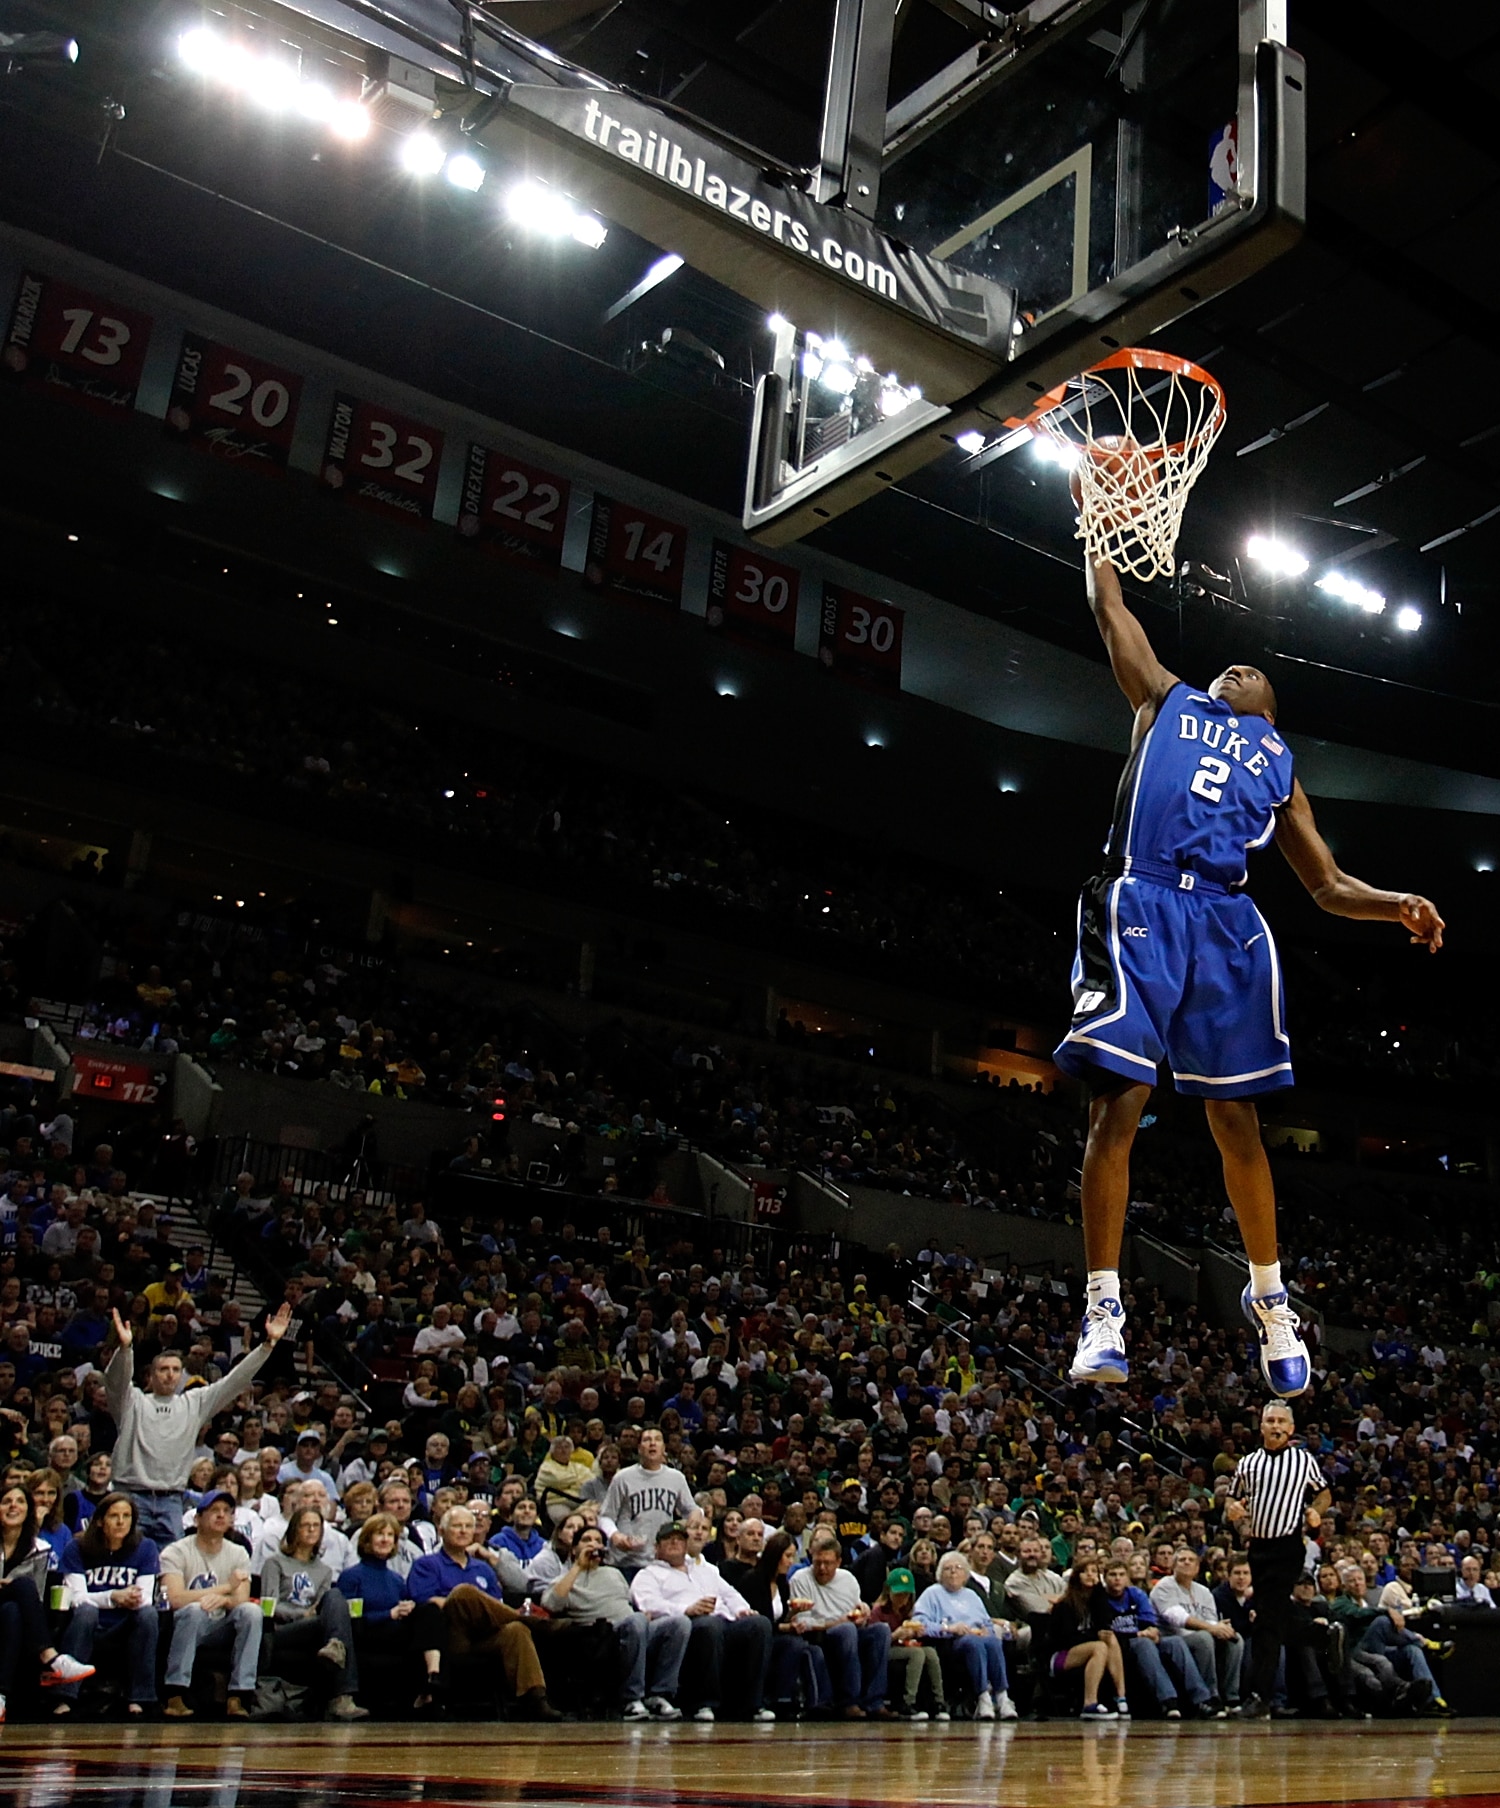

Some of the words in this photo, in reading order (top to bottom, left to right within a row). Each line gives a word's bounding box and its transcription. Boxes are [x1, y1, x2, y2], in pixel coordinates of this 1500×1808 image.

[584, 98, 899, 301] trailblazers.com
[9, 275, 44, 347] TWARDZIK
[59, 308, 131, 366] 13
[179, 347, 202, 394] LUCAS
[208, 364, 291, 428] 20
[328, 402, 354, 461] WALTON
[360, 421, 433, 485] 32
[465, 444, 486, 514] DREXLER
[492, 470, 561, 533] 22
[592, 503, 611, 558] HOLLINS
[623, 520, 675, 573] 14
[713, 549, 728, 598] PORTER
[735, 565, 790, 613] 30
[824, 595, 837, 636] GROSS
[844, 607, 895, 653] 30
[1179, 714, 1269, 777] DUKE
[1190, 756, 1231, 803] 2
[1122, 927, 1148, 937] ACC
[122, 1081, 159, 1104] 112
[757, 1196, 783, 1215] 113
[29, 1341, 62, 1359] DUKE
[630, 1488, 677, 1521] DUKE
[86, 1566, 139, 1586] DUKE
